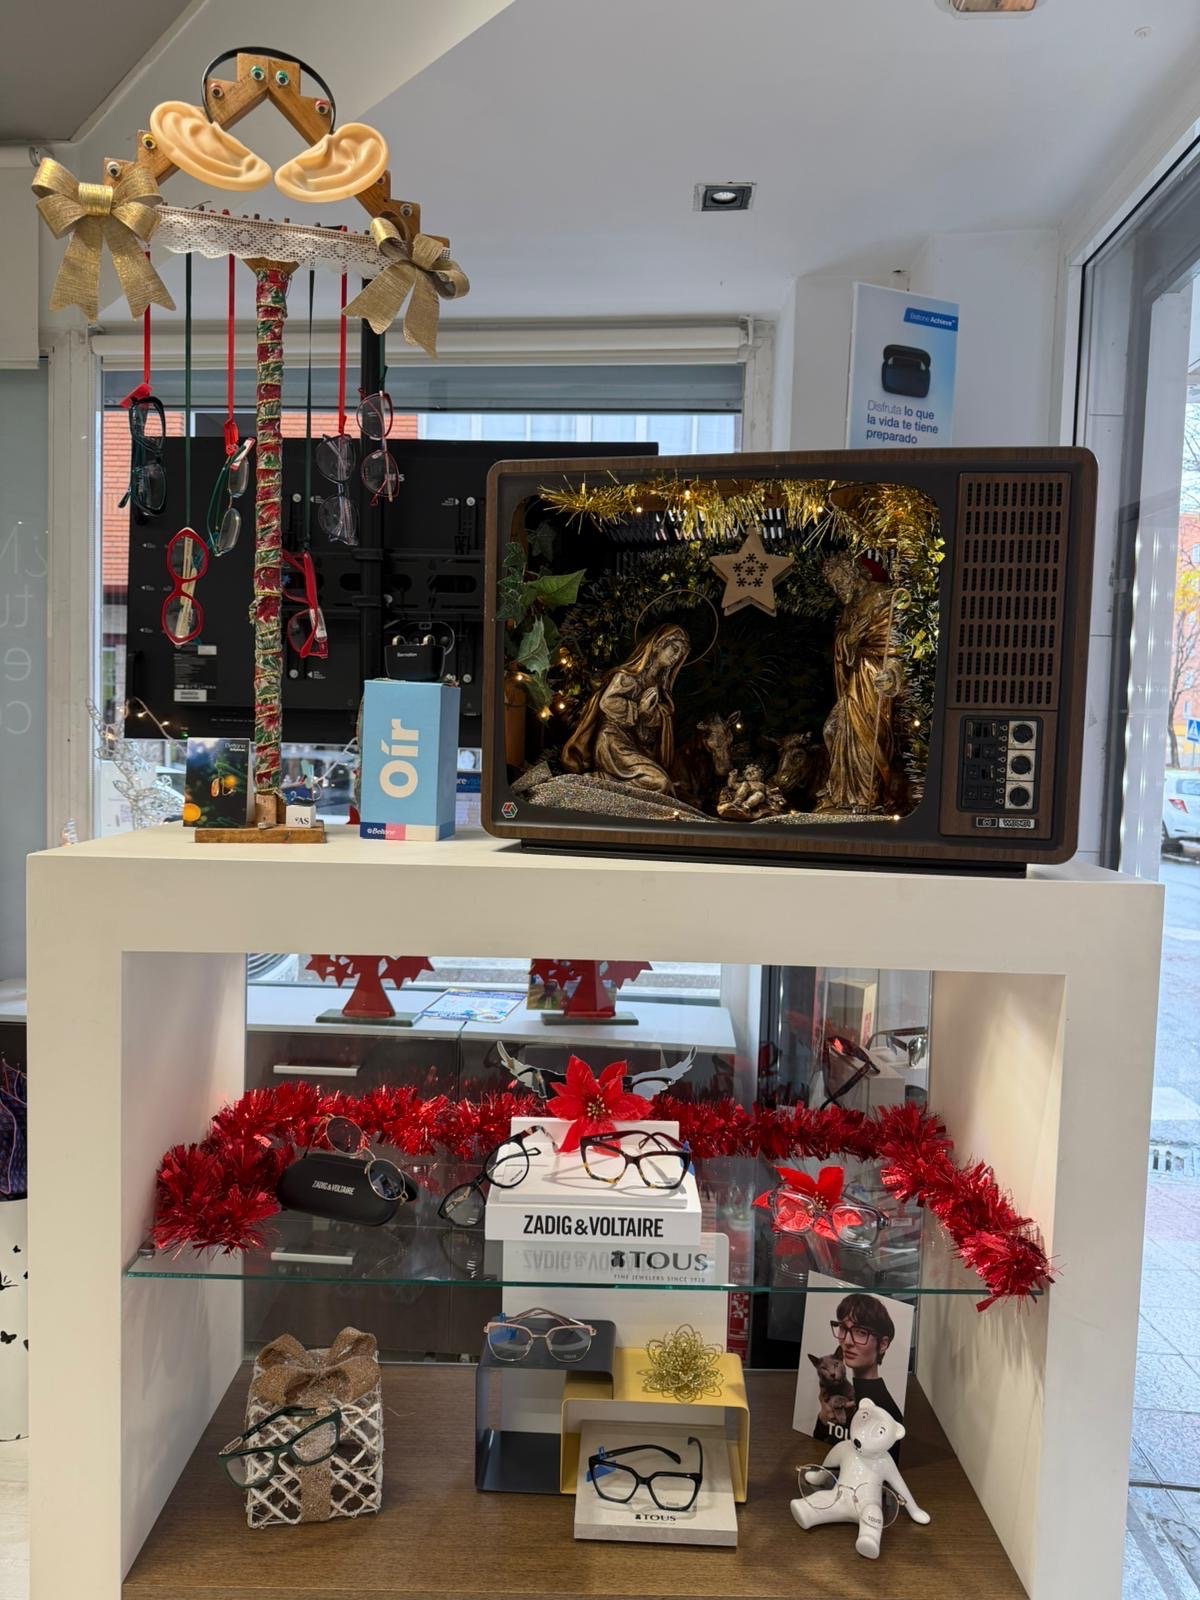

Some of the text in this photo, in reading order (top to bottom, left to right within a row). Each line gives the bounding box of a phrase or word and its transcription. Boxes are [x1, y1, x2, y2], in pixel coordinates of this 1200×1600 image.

[867, 400, 935, 420] Disfruta lo que
[867, 414, 939, 433] la vida te tiene
[866, 429, 918, 444] preparado
[379, 718, 419, 798] Oír
[523, 1214, 664, 1238] ZADIG&VOLTAIRE
[629, 1250, 709, 1272] TOUS
